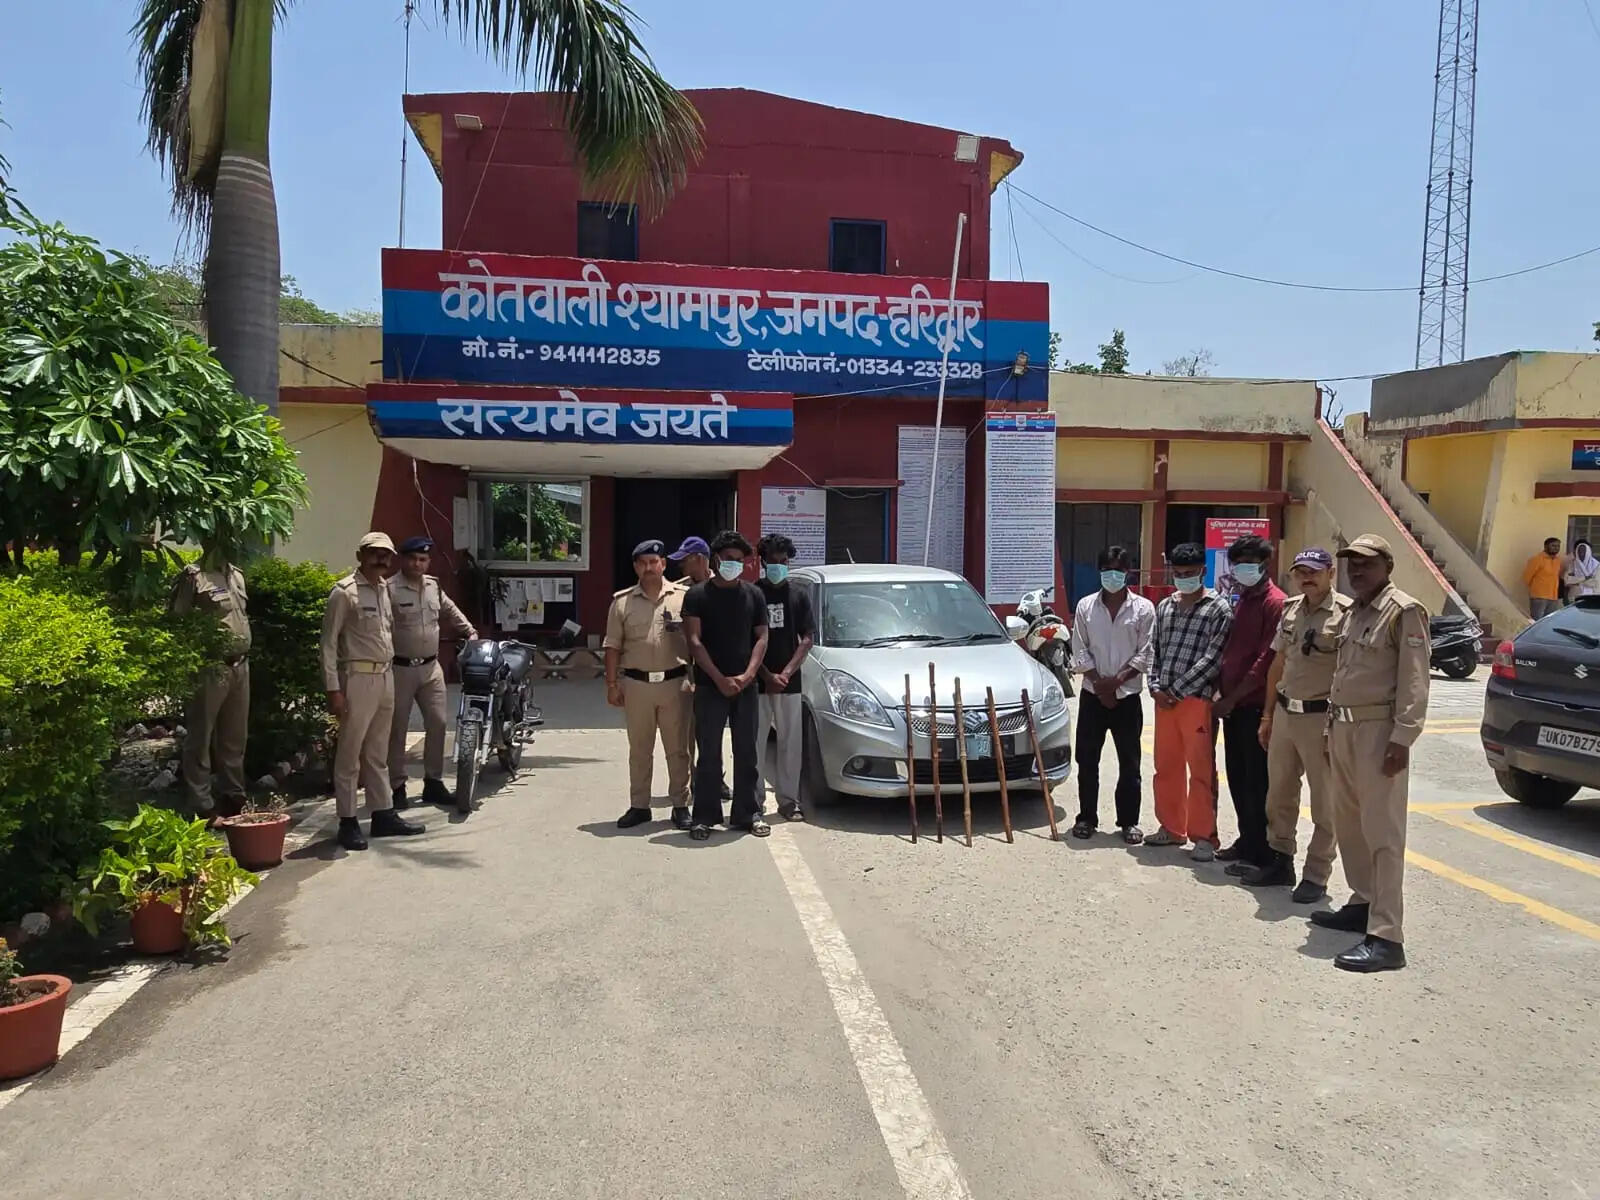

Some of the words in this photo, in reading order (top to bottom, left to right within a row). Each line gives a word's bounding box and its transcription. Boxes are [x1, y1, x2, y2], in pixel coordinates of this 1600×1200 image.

[438, 258, 612, 327] कोतवाली
[540, 345, 661, 366] 9411112835
[437, 390, 621, 437] सत्यमेव
[630, 393, 738, 439] जयते
